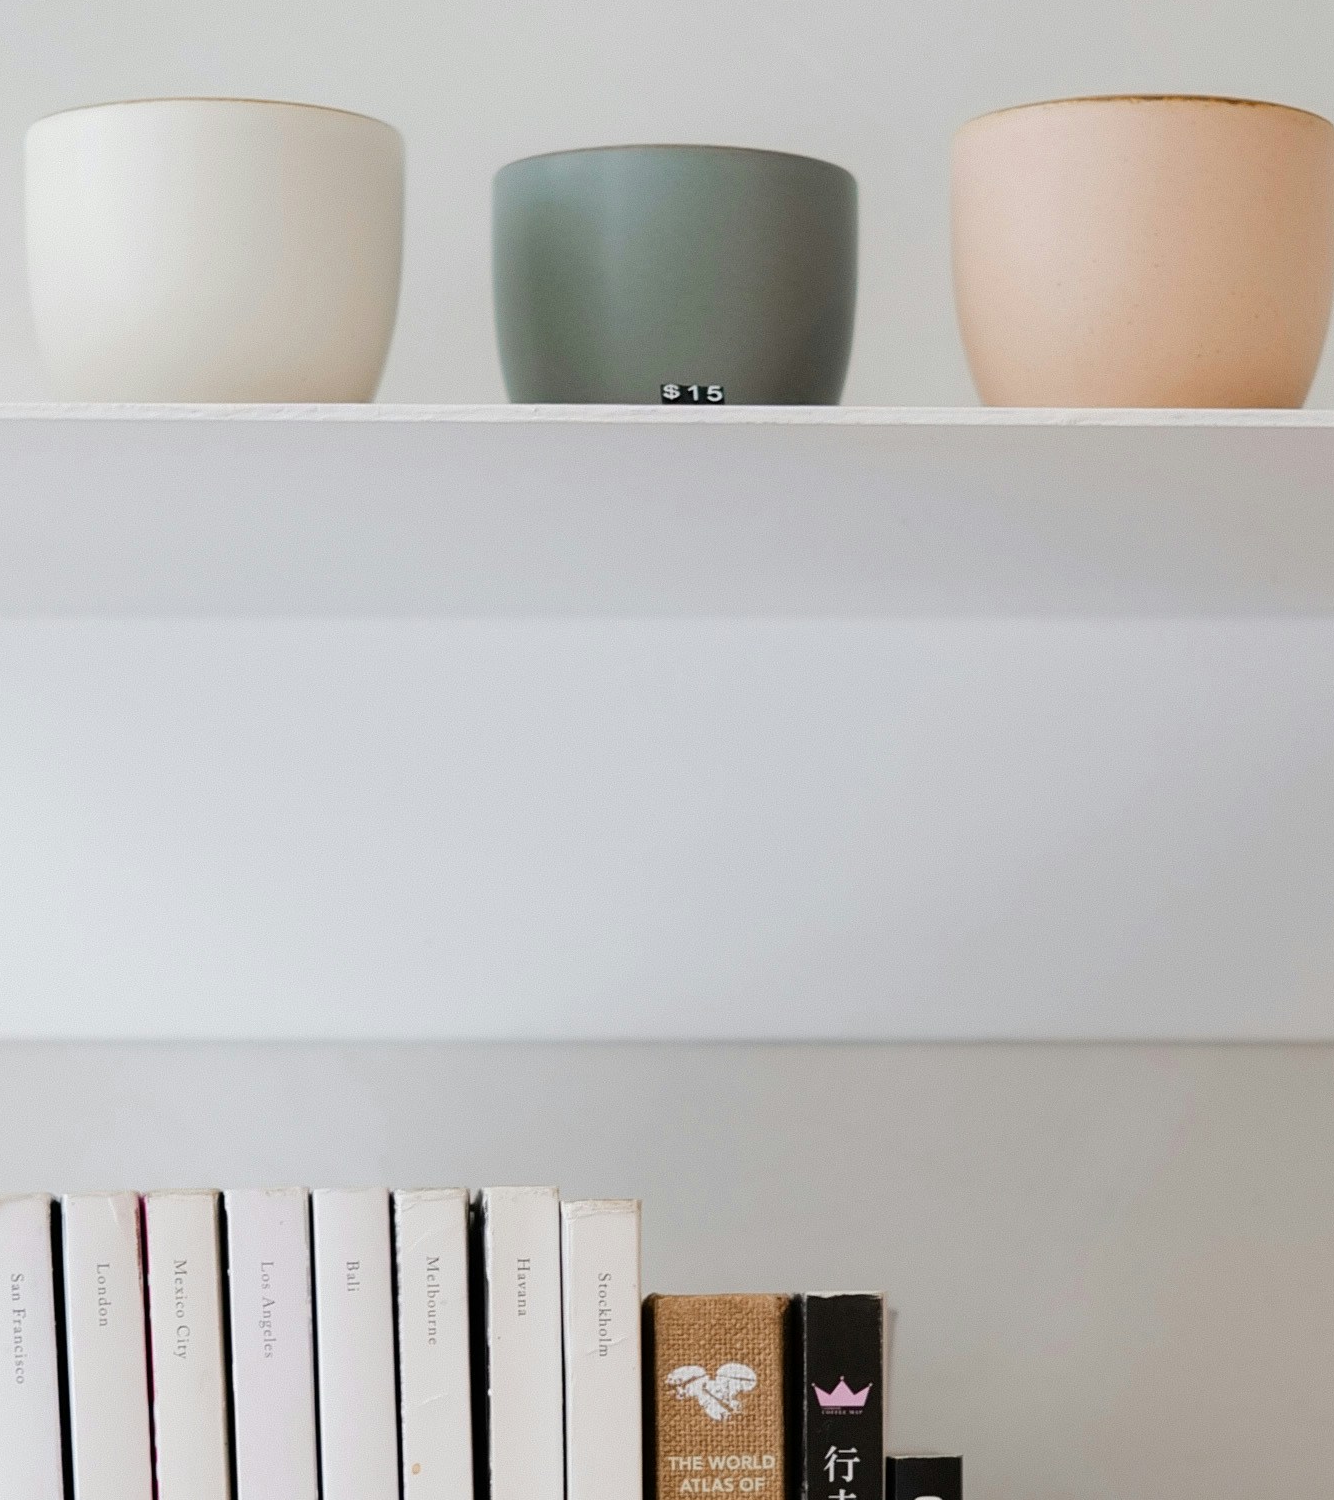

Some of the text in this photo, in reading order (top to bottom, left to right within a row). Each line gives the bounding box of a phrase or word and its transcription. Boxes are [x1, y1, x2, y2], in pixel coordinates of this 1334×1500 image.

[662, 384, 724, 402] $15
[96, 1263, 112, 1327] London
[345, 1260, 361, 1292] Bali
[426, 1256, 441, 1345] Melbourne
[516, 1258, 531, 1317] Havana
[10, 1273, 27, 1385] San Francisco
[173, 1259, 191, 1360] Mexico City
[258, 1261, 277, 1359] Los Angeles
[597, 1272, 612, 1358] Stockholm
[668, 1456, 775, 1470] THE WORLD
[680, 1478, 765, 1493] ATLAS OF
